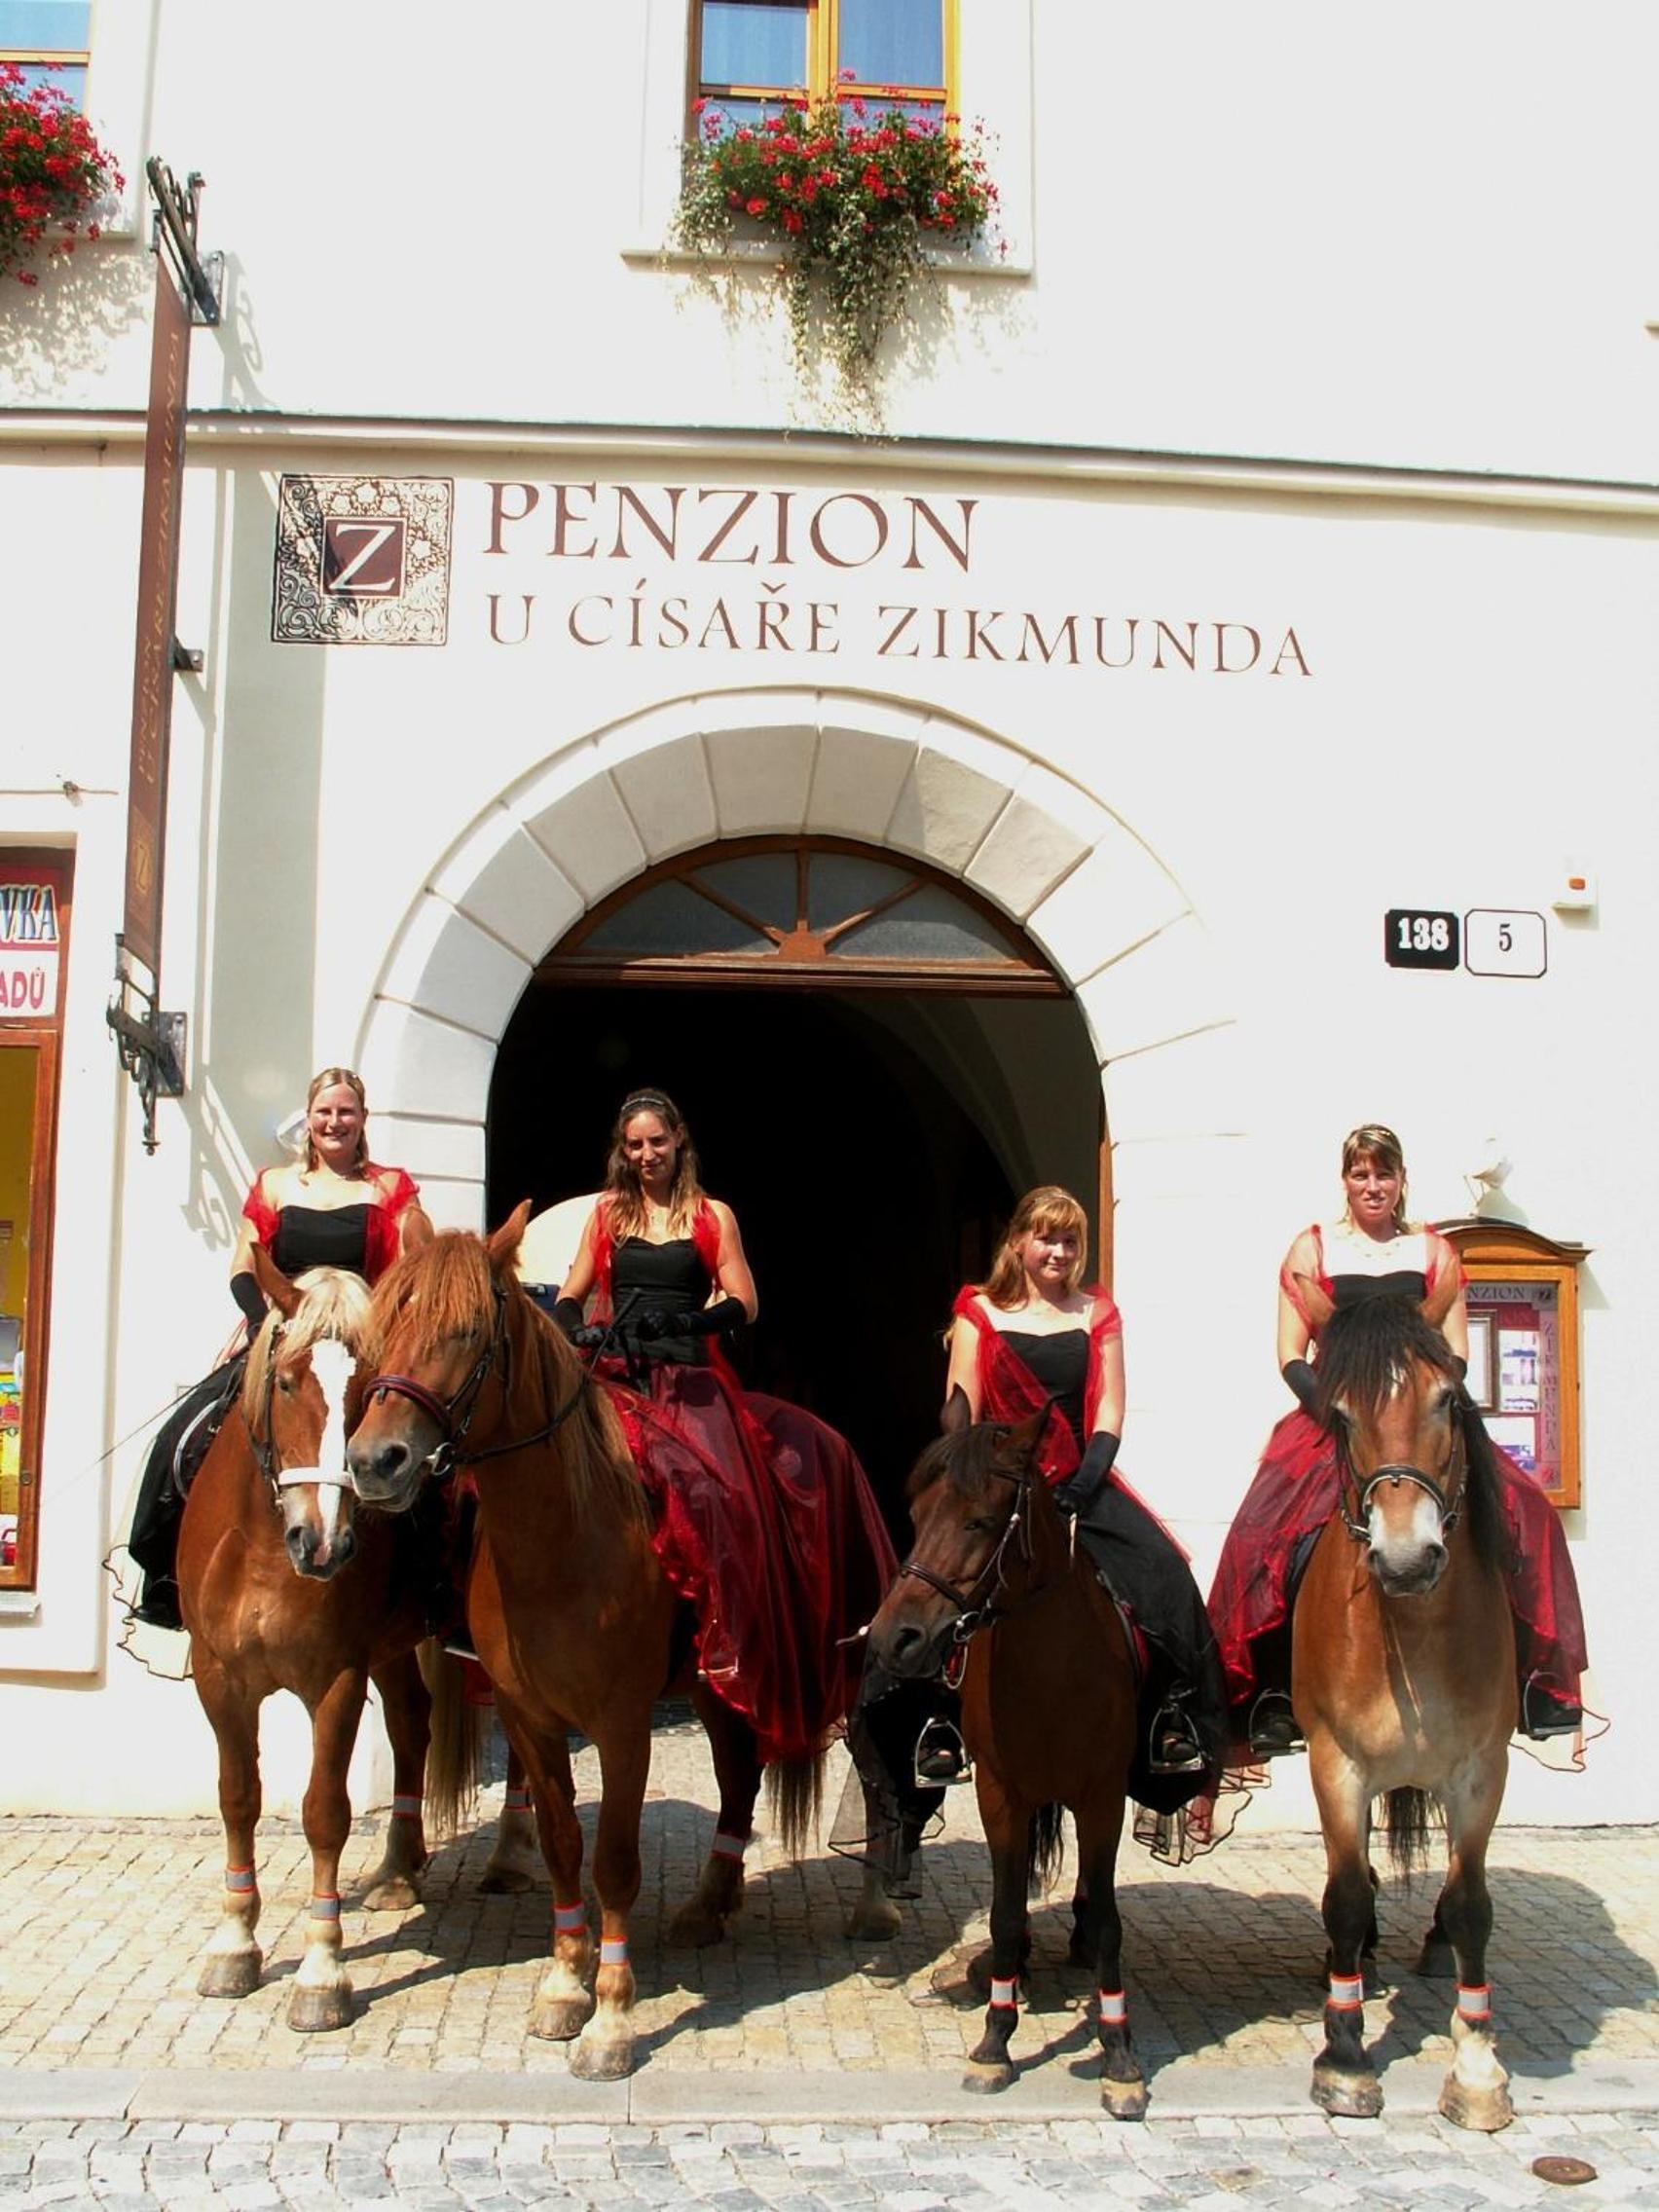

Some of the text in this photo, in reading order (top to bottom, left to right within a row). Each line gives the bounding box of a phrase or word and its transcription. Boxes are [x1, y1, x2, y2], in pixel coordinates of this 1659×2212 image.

[328, 524, 395, 591] Z
[483, 481, 978, 572] PENZION
[488, 577, 1312, 677] U CÍSAŘE ZIKMUNDA
[1398, 917, 1450, 951] 138
[1498, 923, 1513, 952] 5
